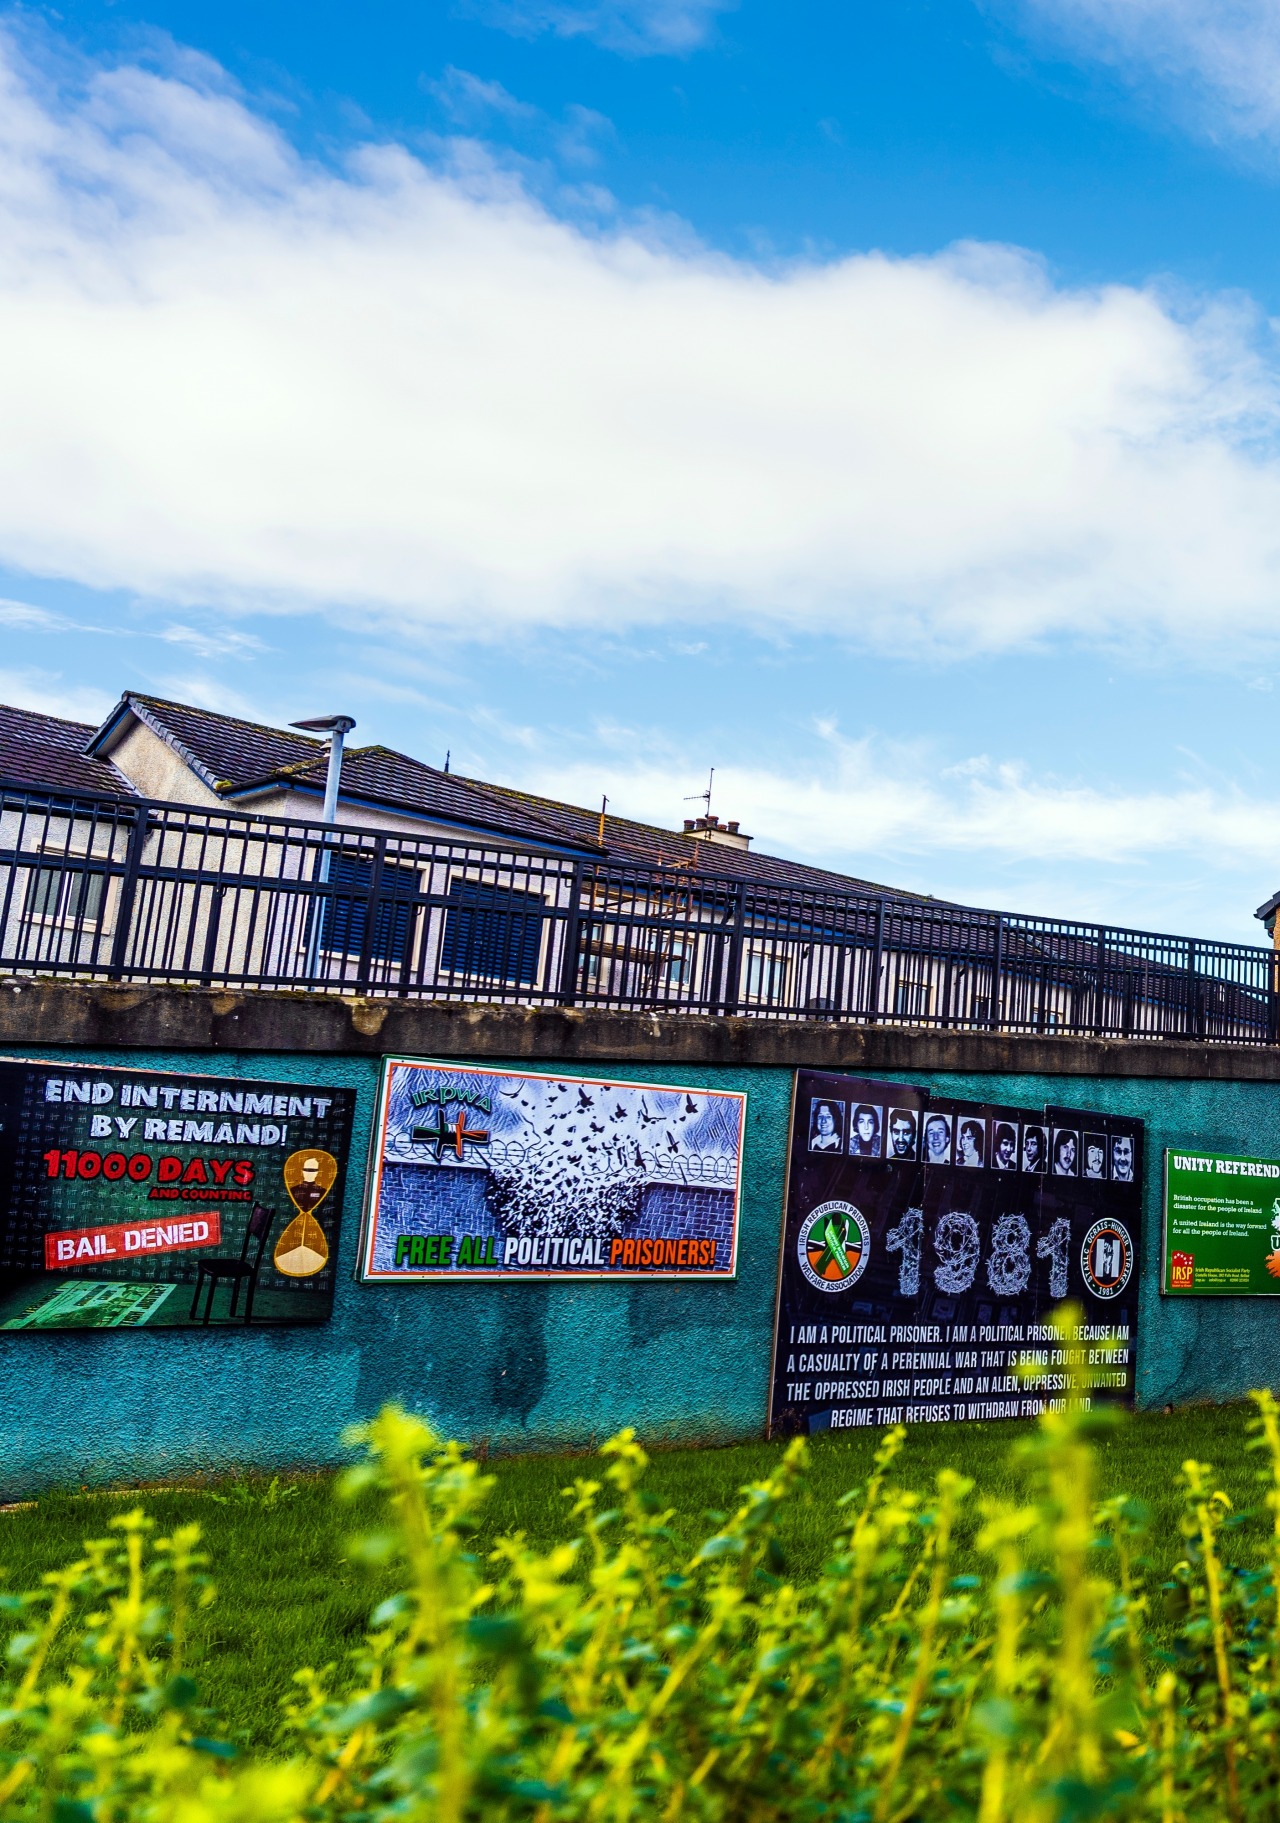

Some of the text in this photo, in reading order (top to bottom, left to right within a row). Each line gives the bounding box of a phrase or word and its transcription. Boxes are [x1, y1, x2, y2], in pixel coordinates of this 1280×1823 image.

[46, 1079, 332, 1118] END INTERNMENT
[412, 1087, 491, 1112] IRPWA
[90, 1115, 288, 1146] BY REMAND!
[44, 1150, 255, 1185] 11000 DAYS
[1173, 1156, 1213, 1173] UNITY
[149, 1188, 251, 1201] AND COUNTING
[1173, 1194, 1193, 1202] British
[1193, 1196, 1225, 1204] occupation
[799, 1201, 869, 1246] IRISH REPUBLICAN PRISONERS
[1198, 1220, 1219, 1228] Ireland
[57, 1221, 209, 1261] BAIL DENIED
[396, 1235, 716, 1265] FREE ALL POLITICAL PRISONERS!
[886, 1207, 1071, 1298] 1981
[801, 1261, 865, 1291] WELFARE ASSOCIATION
[1120, 1251, 1131, 1285] STRIKE
[1172, 1266, 1193, 1280] IRSP
[789, 1326, 795, 1344] I
[797, 1326, 817, 1344] AM
[819, 1326, 828, 1343] A
[831, 1326, 886, 1344] POLITICAL
[889, 1326, 943, 1343] PRISONER.
[945, 1326, 950, 1343] I
[952, 1325, 968, 1343] AM
[970, 1326, 977, 1342] A
[979, 1326, 1024, 1342] POLITICAL
[1072, 1325, 1110, 1341] BECAUSE
[1117, 1325, 1129, 1340] AM
[786, 1348, 1129, 1373] A CASUALTY OF A PERENNIAL WAR THAT IS BEING FOUGHT BETWEEN
[787, 1372, 1127, 1401] THE OPPRESSED IRISH PEOPLE AND AN ALIEN, OPPRESSIVE, UNWANTED
[830, 1408, 874, 1428] REGIME
[876, 1406, 903, 1425] THAT
[906, 1404, 951, 1423] REFUSES
[953, 1403, 966, 1421] TO
[968, 1401, 1019, 1420] WITHDRAW
[1021, 1399, 1047, 1417] FROM
[1049, 1398, 1067, 1415] OUR
